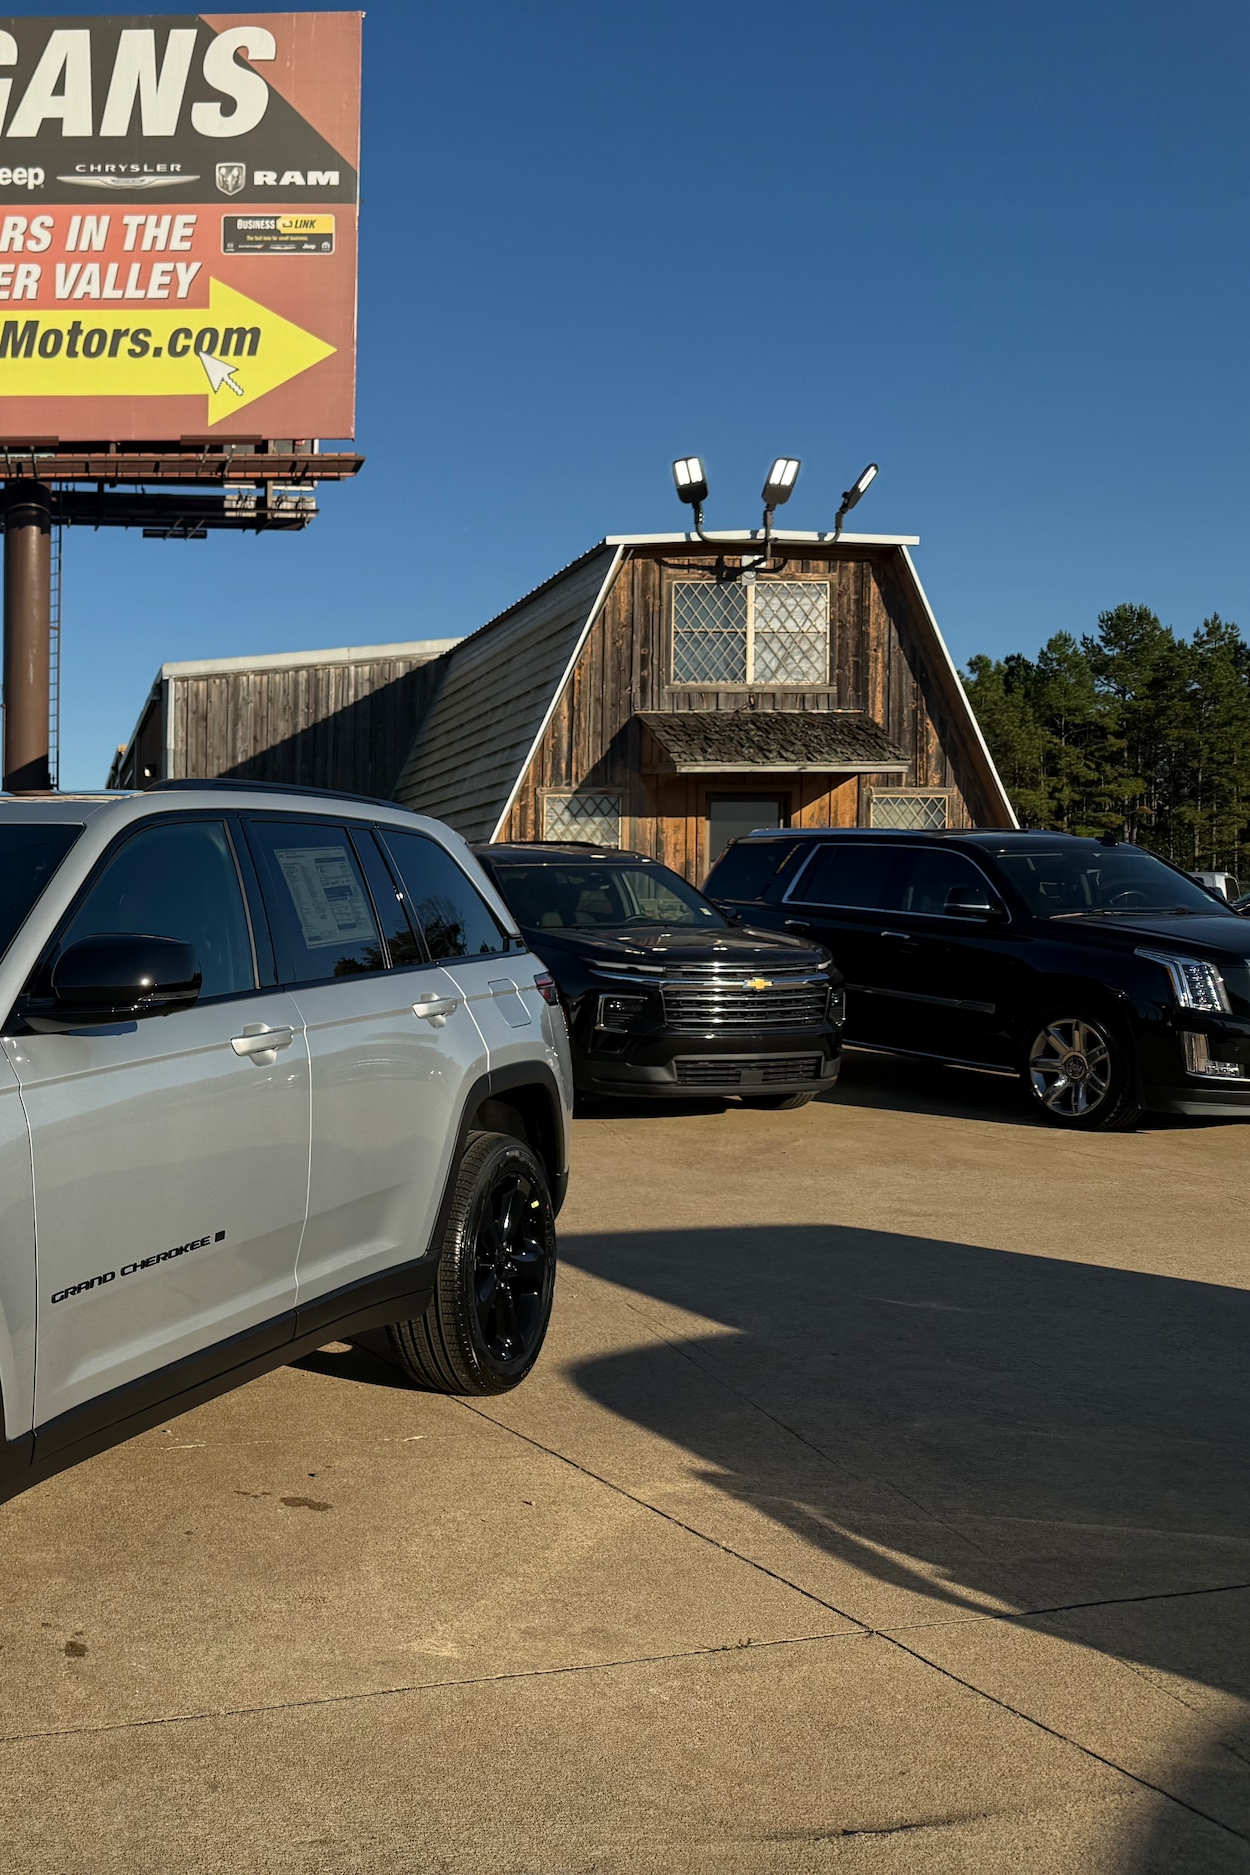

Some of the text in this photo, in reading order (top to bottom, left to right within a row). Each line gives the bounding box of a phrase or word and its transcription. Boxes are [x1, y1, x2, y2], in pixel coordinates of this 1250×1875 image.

[75, 163, 182, 173] CHRYSLER
[253, 170, 340, 186] RAM
[65, 215, 111, 252] IN
[122, 214, 197, 251] THE
[294, 219, 317, 229] LINK
[55, 262, 202, 299] VALLEY
[51, 1235, 211, 1304] GRAND CHEROKEE
